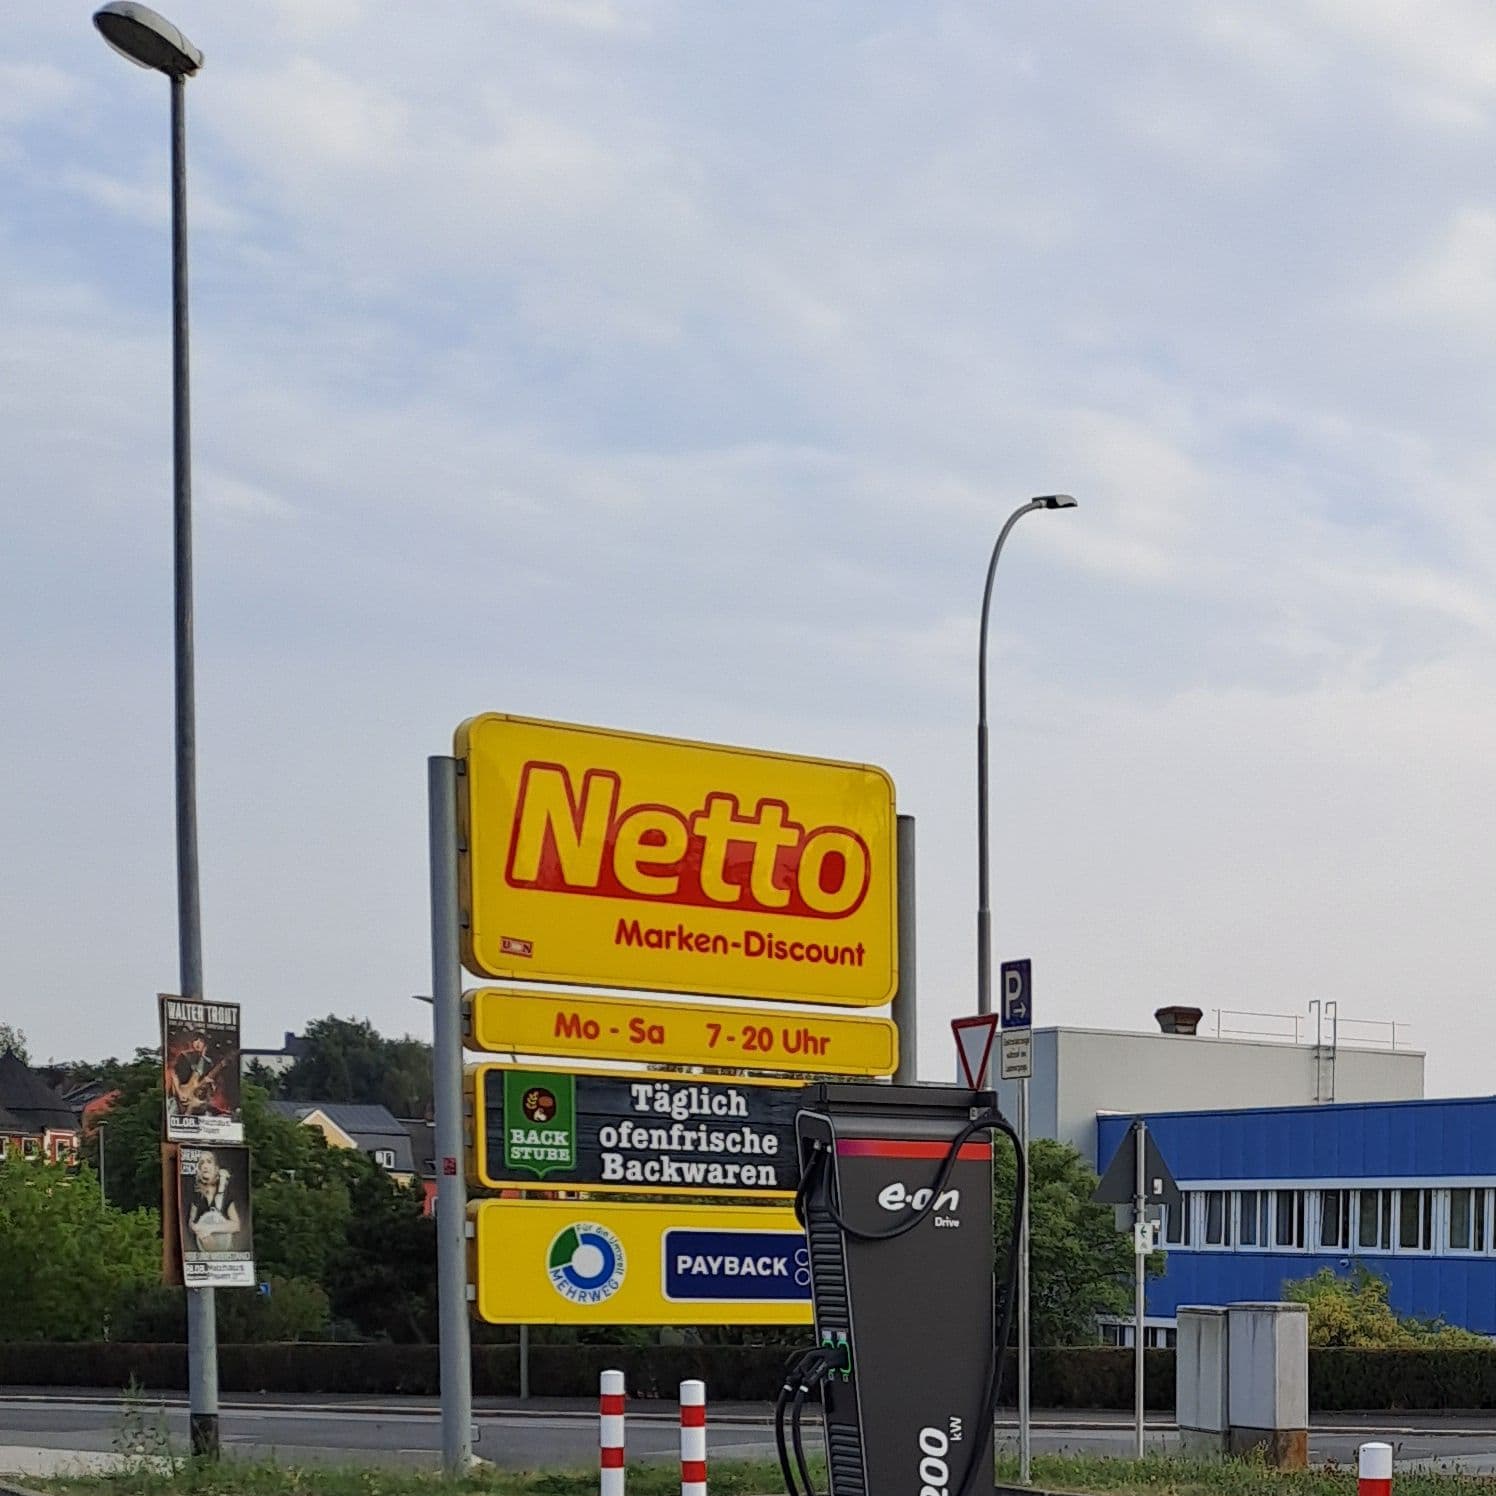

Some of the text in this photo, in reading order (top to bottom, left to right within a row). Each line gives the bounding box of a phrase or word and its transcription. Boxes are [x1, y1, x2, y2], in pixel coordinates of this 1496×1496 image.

[505, 759, 872, 919] Netto
[614, 917, 866, 967] Marken-Discount
[168, 1001, 204, 1021] WALTER
[203, 1005, 238, 1025] TROUT
[554, 1012, 600, 1040] Mo
[628, 1017, 665, 1045] Sa
[782, 1028, 831, 1056] Uhr
[630, 1083, 749, 1120] Täglich
[510, 1128, 569, 1147] BACK
[510, 1146, 571, 1162] STUBE
[599, 1121, 779, 1155] ofenfrische
[601, 1153, 778, 1186] Backwaren
[934, 1216, 960, 1228] Drive
[676, 1255, 789, 1277] PAYBACK
[549, 1269, 619, 1303] MEHRWEG
[950, 1416, 962, 1441] kW
